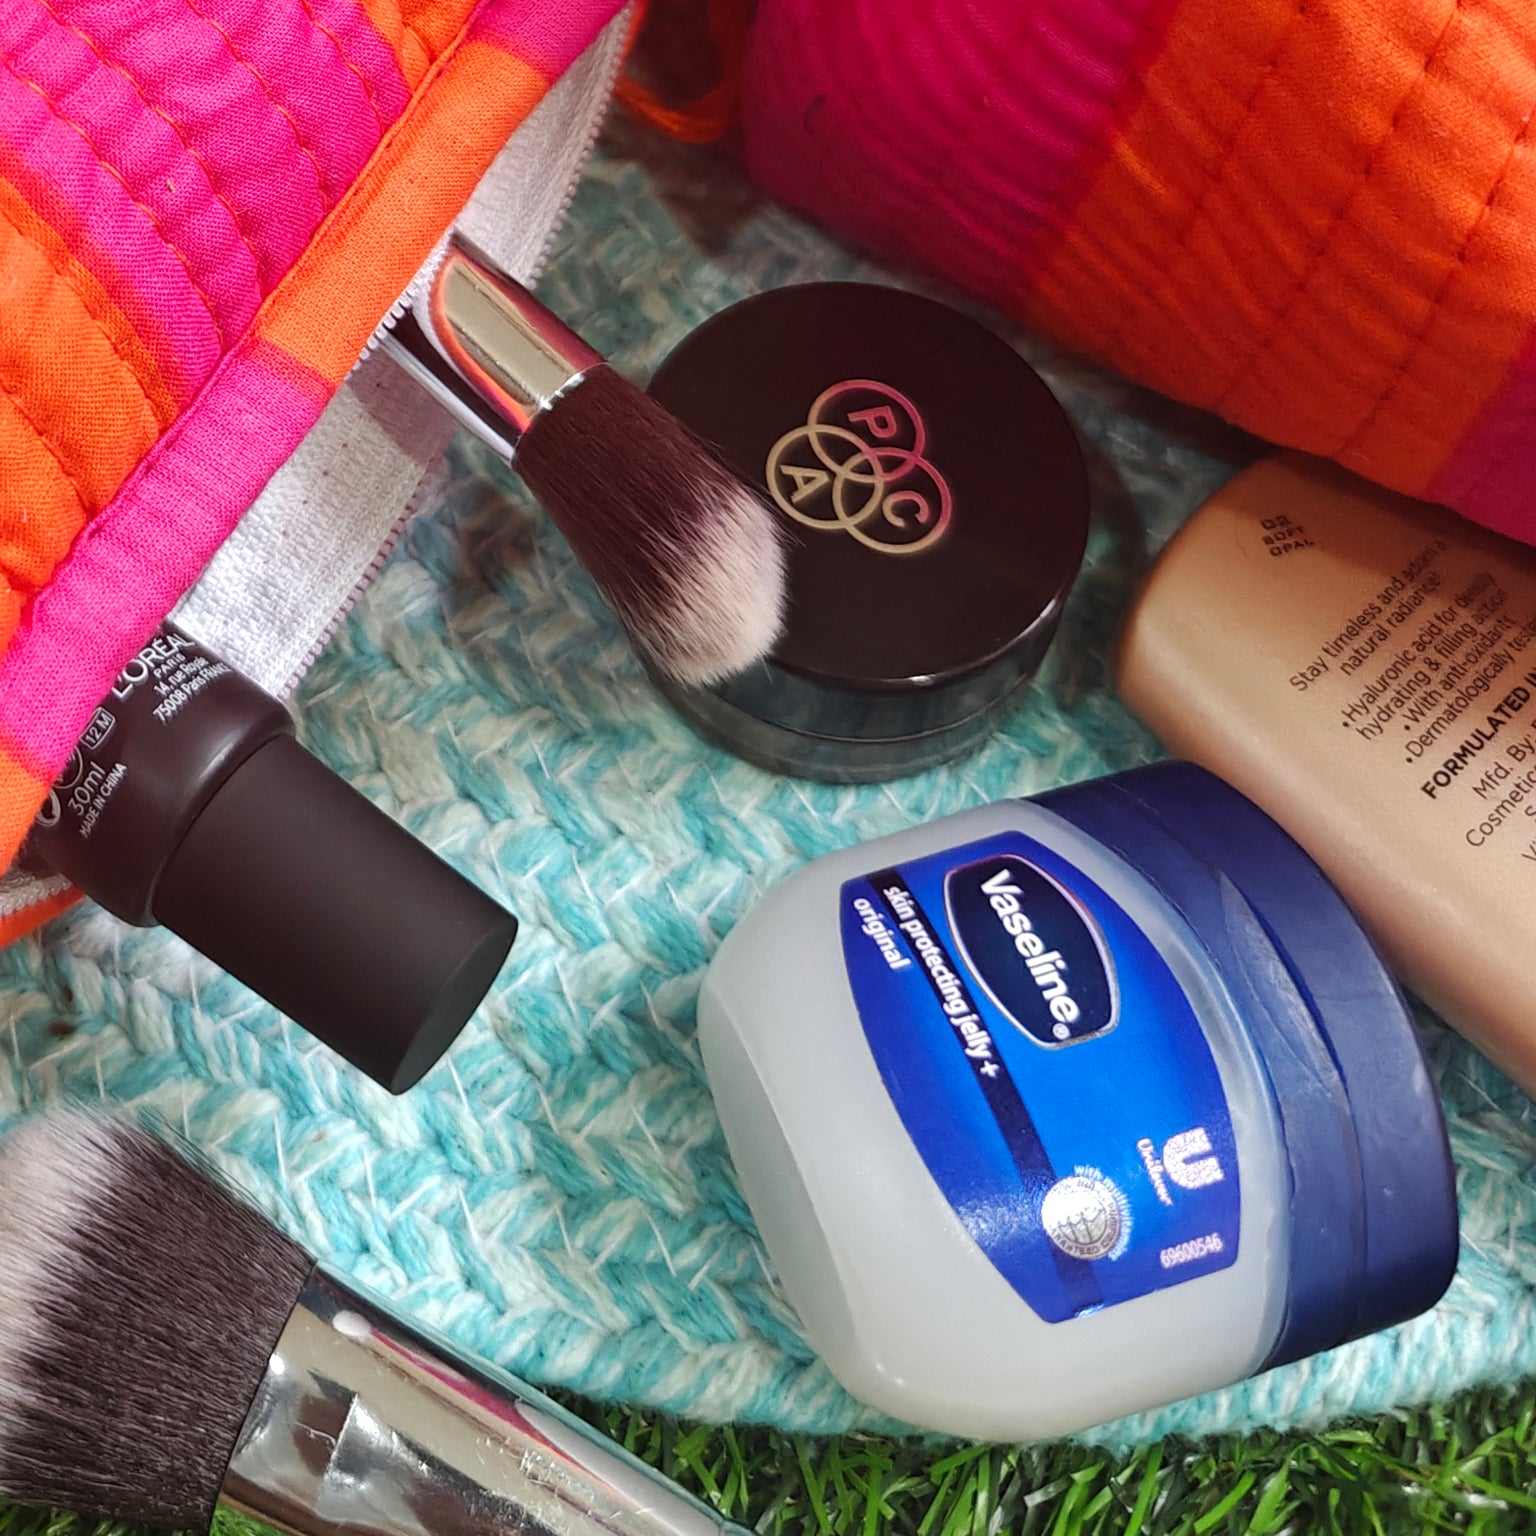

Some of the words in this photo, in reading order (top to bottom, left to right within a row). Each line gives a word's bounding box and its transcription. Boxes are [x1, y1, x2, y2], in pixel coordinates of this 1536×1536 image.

[110, 632, 196, 700] L'ORÉAL
[1289, 655, 1329, 692] Stay
[1321, 602, 1383, 658] timeless
[1376, 575, 1406, 605] and
[1340, 623, 1391, 676] natural
[1341, 648, 1417, 723] Hyaluronic
[1412, 620, 1443, 653] acid
[1434, 605, 1458, 628] for
[152, 688, 188, 722] 75008
[180, 676, 206, 697] Paris
[167, 669, 187, 685] rue
[1355, 669, 1432, 741] hydrating
[1423, 656, 1441, 672] &
[1433, 621, 1478, 660] filling
[1402, 689, 1444, 724] With
[1404, 647, 1515, 758] Dermatologically
[1506, 619, 1536, 652] teste
[85, 726, 102, 744] 12
[95, 712, 112, 730] M
[1420, 686, 1531, 801] FORMULATED
[67, 761, 106, 816] 30ml
[79, 806, 101, 839] MADE
[92, 794, 107, 811] IN
[100, 762, 128, 797] CHINA
[1466, 765, 1536, 847] Cosmetic
[1472, 761, 1514, 801] Mfd.
[853, 897, 912, 971] original
[882, 885, 916, 921] skin
[899, 917, 969, 1015] protecting
[949, 1013, 993, 1060] jelly
[1136, 1137, 1173, 1207] Unilever
